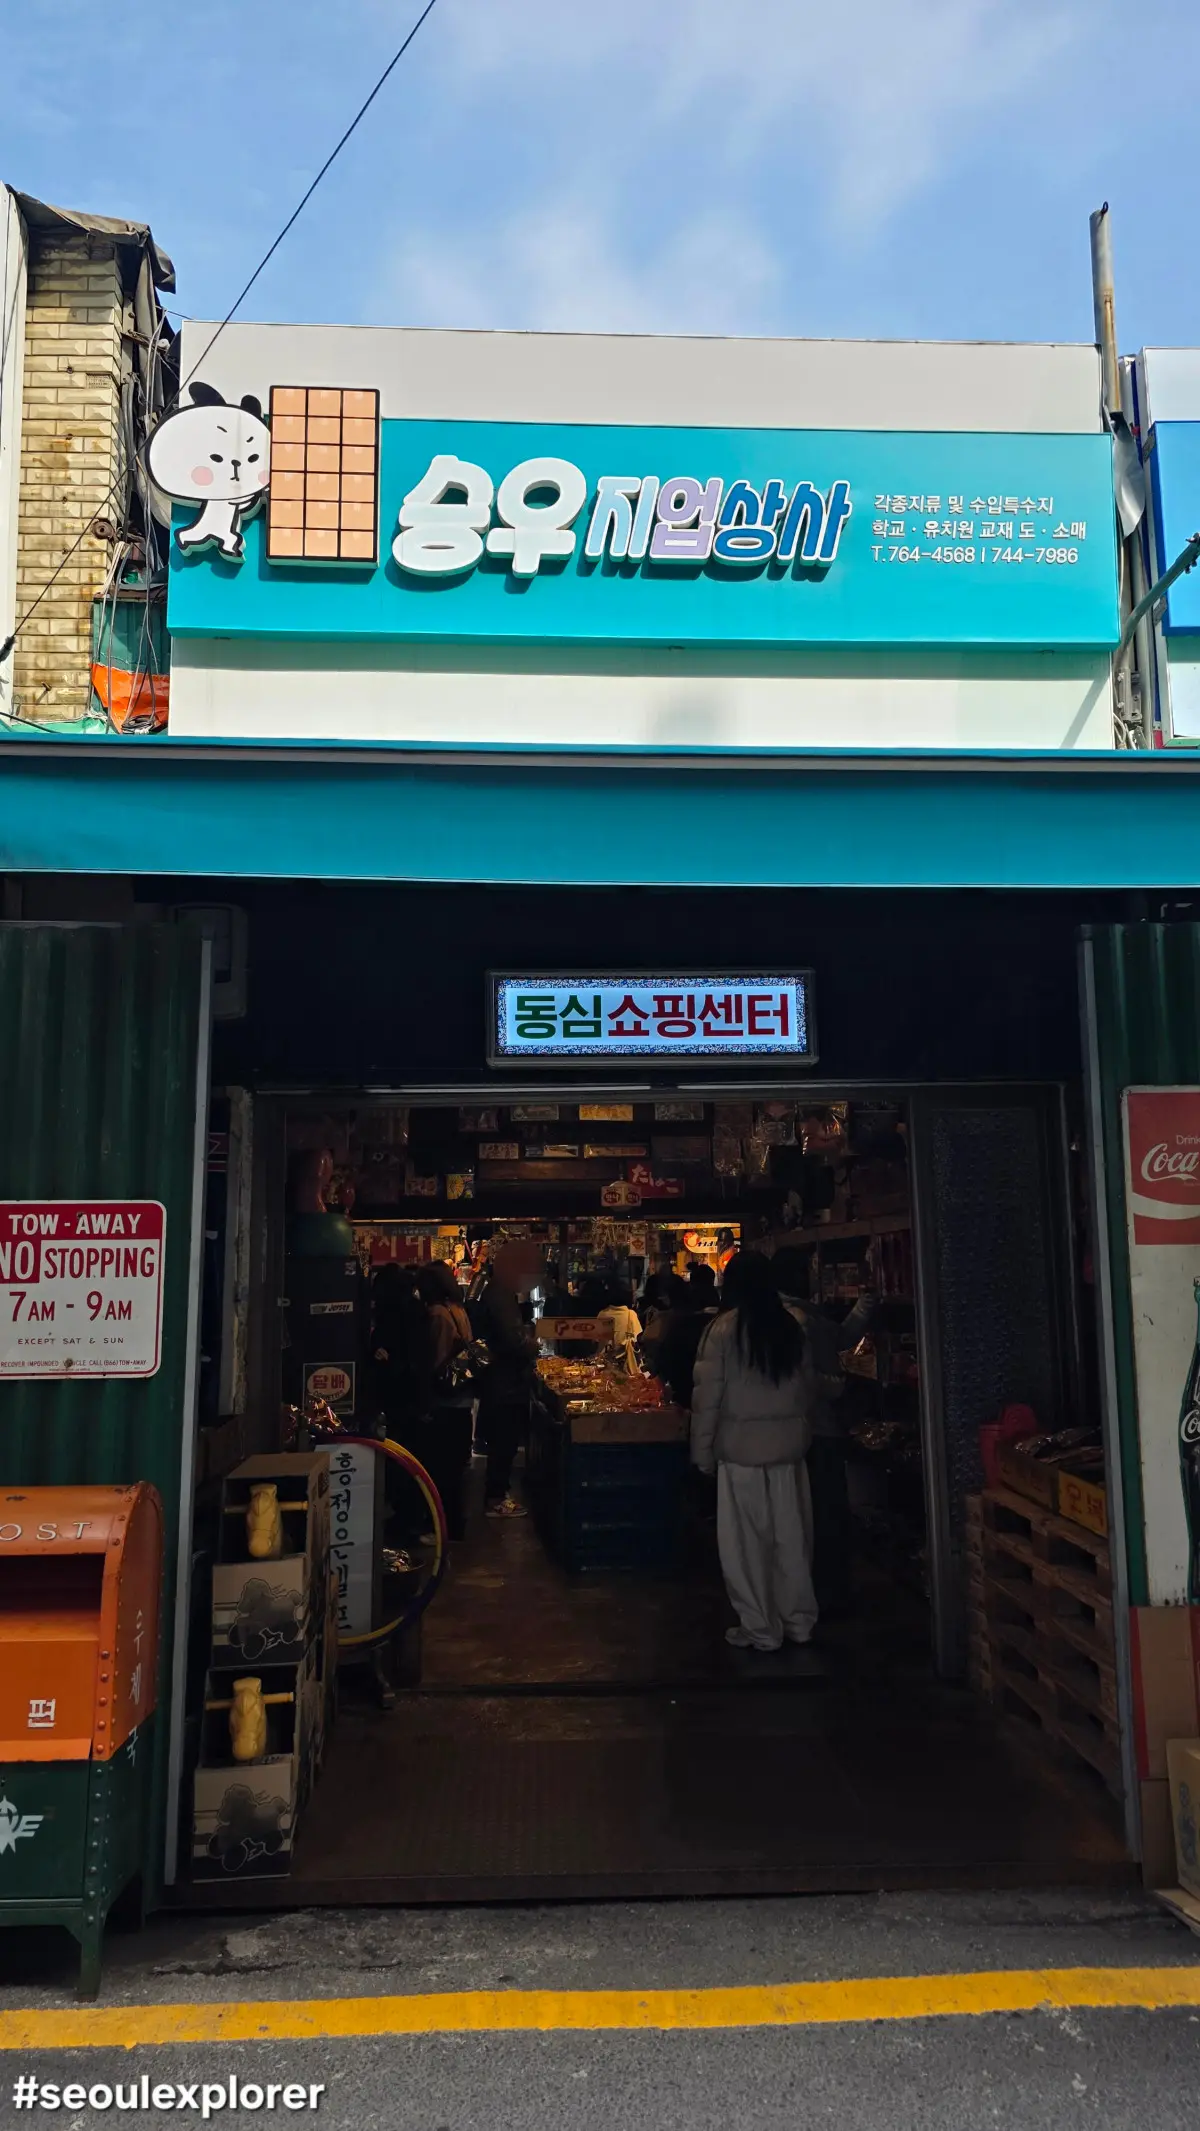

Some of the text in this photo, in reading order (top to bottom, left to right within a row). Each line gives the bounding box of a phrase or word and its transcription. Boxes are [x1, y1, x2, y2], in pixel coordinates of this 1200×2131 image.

[874, 494, 1054, 515] 각종지류 및 수입특수지
[872, 520, 906, 538] 학교
[923, 521, 974, 539] 유치원
[979, 521, 1013, 540] 교재
[1019, 522, 1036, 539] 도
[1052, 521, 1087, 540] 소매
[991, 547, 1079, 564] 744-7986
[8, 1213, 59, 1235] TOW
[76, 1213, 142, 1235] AWAY
[0, 1240, 156, 1280] NO STOPPING
[17, 1336, 125, 1346] EXCEPT SAT & SUN
[88, 1359, 103, 1367] CALL
[27, 1698, 57, 1729] 편
